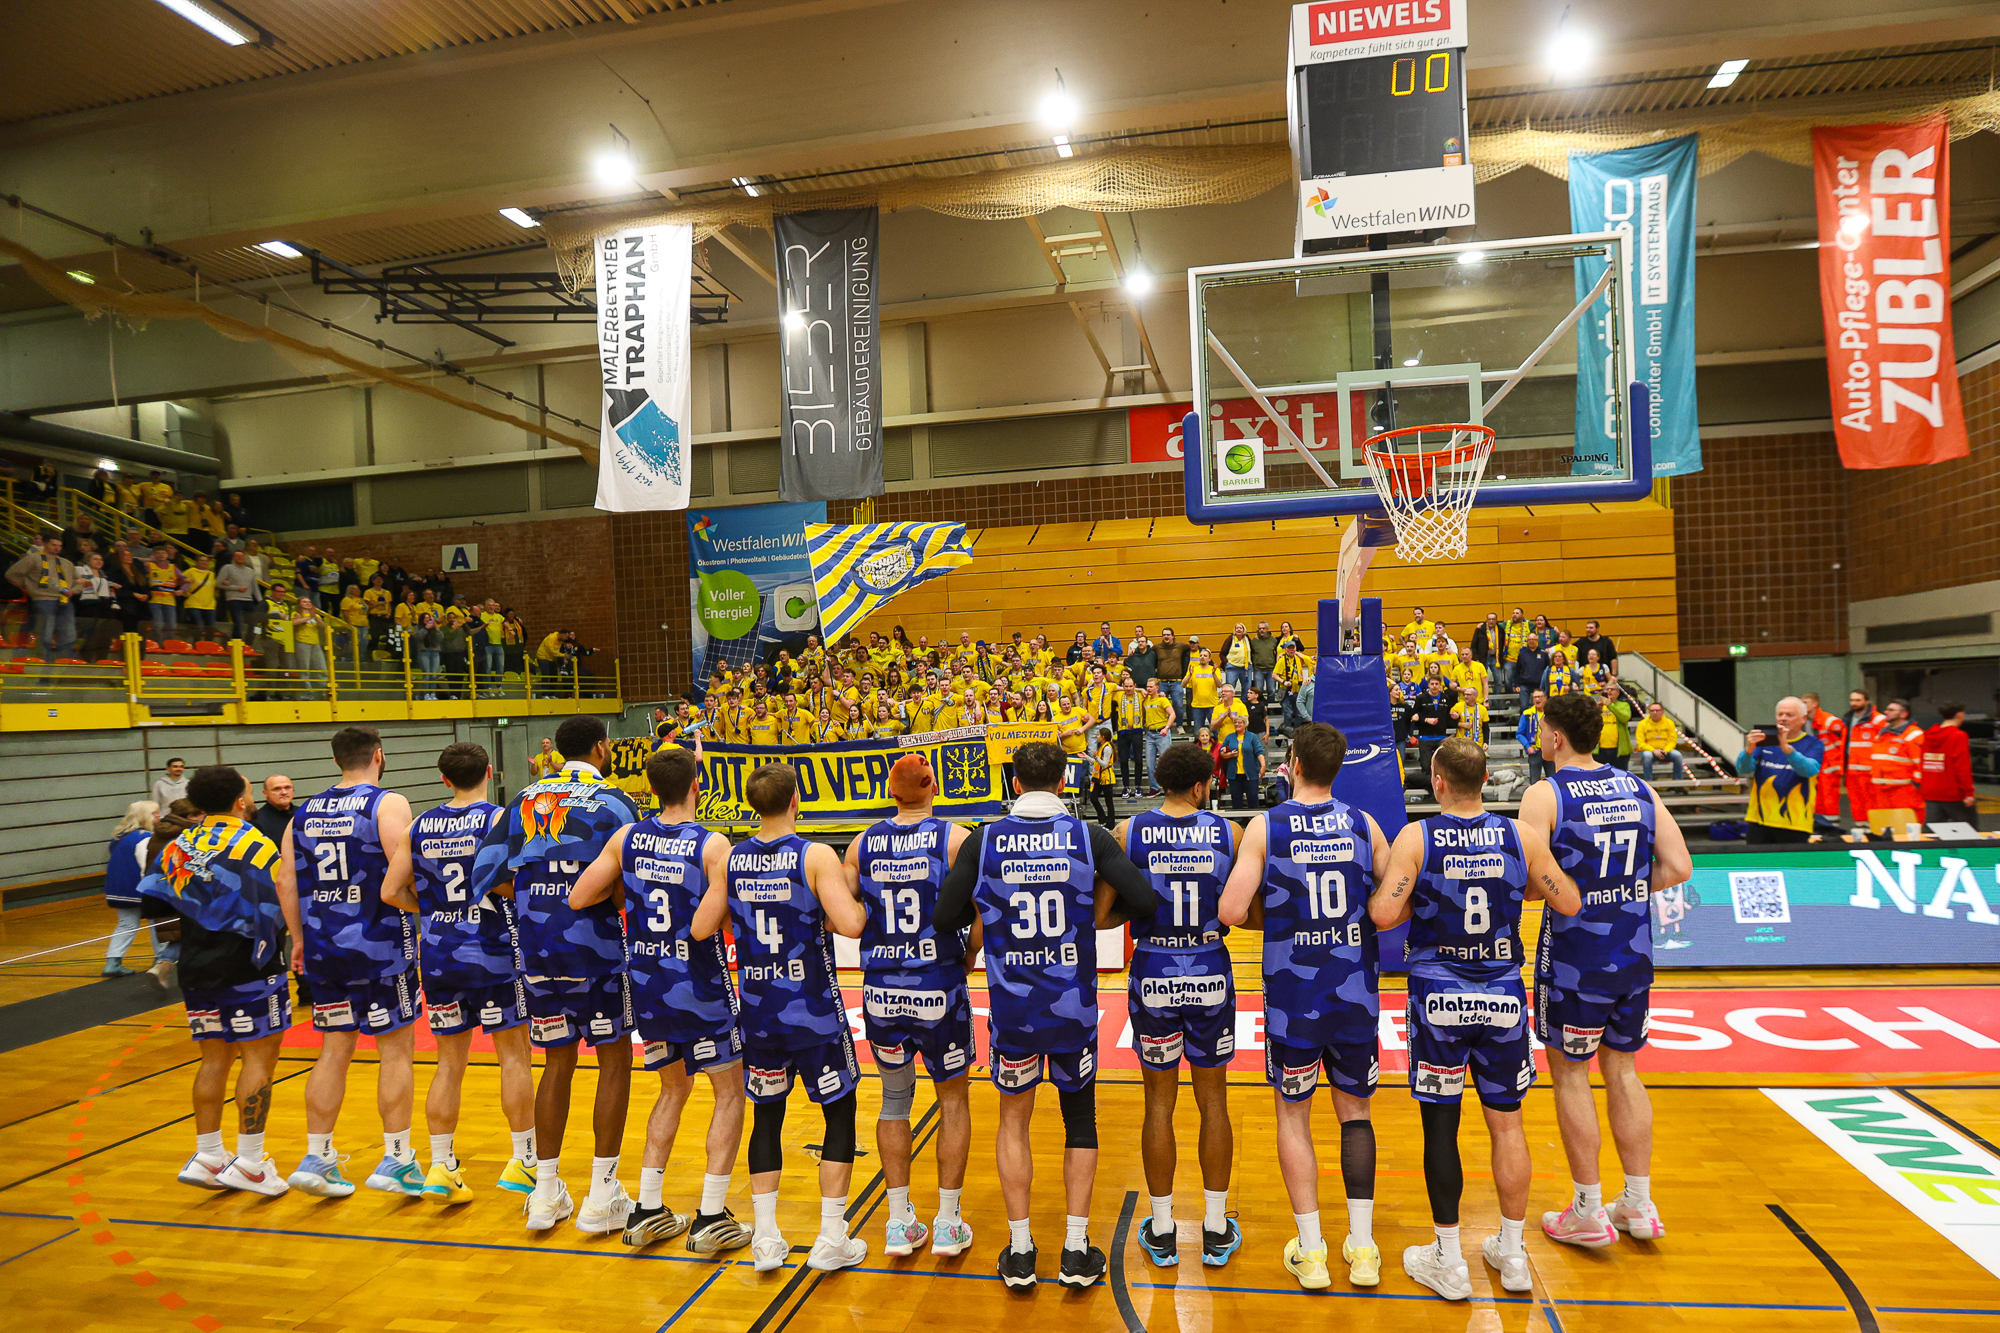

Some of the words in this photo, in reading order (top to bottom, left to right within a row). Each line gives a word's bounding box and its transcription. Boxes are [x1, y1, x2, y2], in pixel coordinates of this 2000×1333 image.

[1317, 0, 1443, 37] NIEWELS
[1310, 45, 1366, 61] Kompetenz
[1368, 42, 1392, 57] fühlt
[1395, 37, 1415, 50] sich
[1417, 37, 1434, 51] gut
[1332, 202, 1471, 230] WestfalenWIND
[1648, 181, 1661, 282] SYSTEMHAUS
[649, 233, 659, 273] GmbH
[1648, 284, 1661, 298] IT
[1870, 145, 1945, 428] ZUBLER
[603, 237, 619, 386] MALERBETRIEB
[624, 235, 646, 385] TRAPHAN
[851, 236, 872, 451] GEBÄUDEREINIGUNG
[1647, 309, 1663, 357] GmbH
[785, 241, 836, 456] BIEBER
[1166, 399, 1328, 459] aixit
[1560, 453, 1609, 465] SPALDING
[1223, 477, 1260, 486] BARMER
[712, 533, 807, 553] WestfalenWIN
[450, 546, 471, 571] A
[697, 558, 727, 567] Ökostrom
[730, 555, 767, 565] Photovoltaik
[771, 552, 809, 562] Gebäudetech
[709, 589, 746, 602] Voller
[704, 605, 753, 621] Energie!
[989, 730, 1054, 742] VOLMESTADT
[1566, 776, 1640, 799] RISSETTO
[306, 796, 369, 813] UHLEMANN
[1585, 803, 1639, 818] platzmann
[419, 813, 487, 834] NAWROCKI
[1289, 813, 1350, 833] BLECK
[631, 832, 697, 857] SCHWIEGER
[867, 835, 888, 853] VON
[891, 831, 938, 852] WAADEN
[995, 832, 1078, 853] CARROLL
[1433, 827, 1506, 847] SCHMIDT
[1292, 841, 1353, 856] platzmann
[1593, 829, 1639, 878] 77
[314, 841, 349, 881] 21
[872, 861, 927, 874] platzmann
[1003, 861, 1068, 876] platzmann
[1150, 853, 1213, 866] platzmann
[442, 862, 467, 903] 2
[737, 881, 789, 893] platzmann
[1024, 873, 1051, 881] federn
[530, 880, 573, 896] mark
[1305, 870, 1348, 919] 10
[1587, 884, 1633, 906] mark
[647, 888, 672, 932] 3
[880, 888, 921, 934] 13
[1009, 889, 1066, 939] 30
[1170, 881, 1199, 927] 11
[1463, 886, 1491, 934] 8
[401, 916, 411, 937] wilo
[431, 908, 464, 924] mark
[508, 925, 519, 947] wilo
[755, 909, 784, 954] 4
[1150, 933, 1199, 948] mark
[1294, 926, 1343, 946] mark
[403, 938, 413, 960] wilo
[634, 940, 671, 957] mark
[871, 941, 916, 959] mark
[1005, 947, 1057, 966] mark
[1438, 942, 1490, 960] mark
[1541, 947, 1550, 973] wilo
[721, 968, 732, 991] wilo
[728, 992, 738, 1016] wilo
[822, 947, 832, 971] wilo
[828, 973, 838, 997] wilo
[834, 998, 845, 1023] wilo
[1143, 980, 1225, 998] platzmann
[864, 989, 944, 1008] platzmann
[1170, 993, 1203, 1005] federn
[1428, 996, 1519, 1014] platzmann
[884, 1006, 919, 1017] federn
